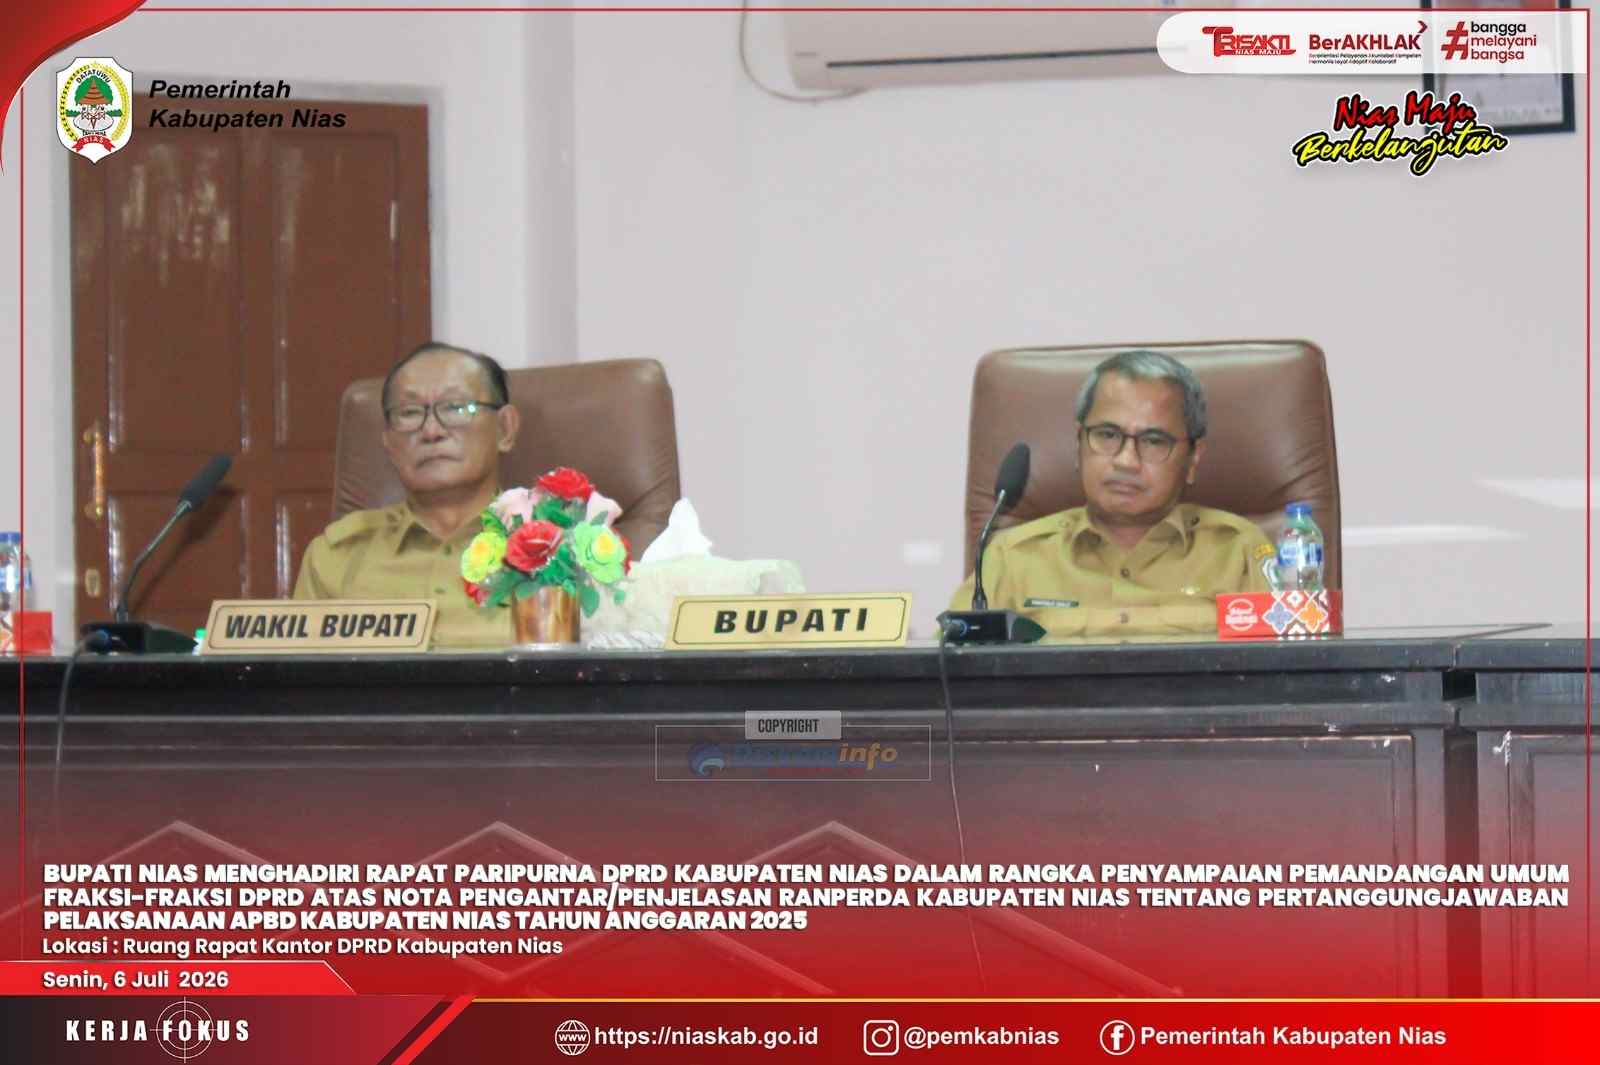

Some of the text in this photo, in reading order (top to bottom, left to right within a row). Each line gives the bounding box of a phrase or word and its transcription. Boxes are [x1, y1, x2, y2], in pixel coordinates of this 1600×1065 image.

[225, 613, 417, 639] WAKIL BUPATI
[713, 607, 869, 634] BUPATI
